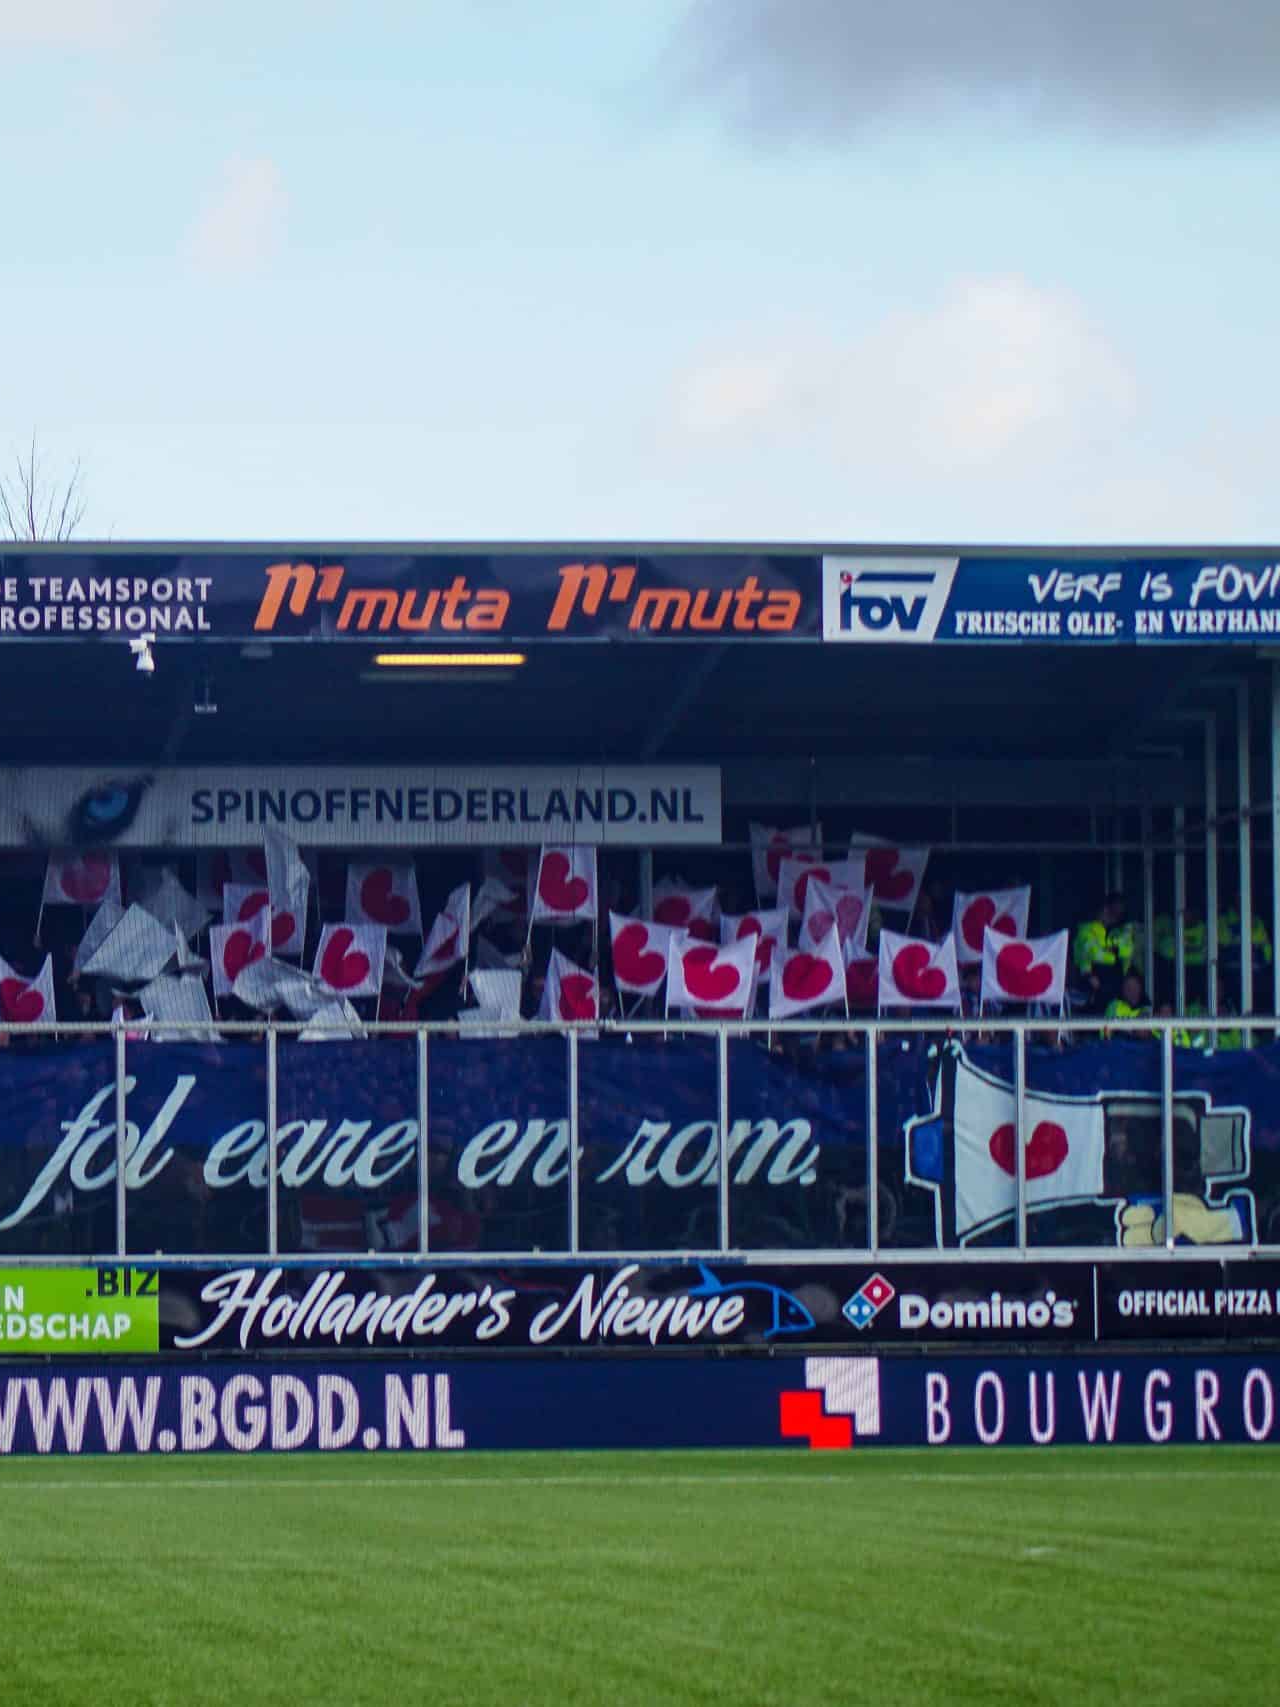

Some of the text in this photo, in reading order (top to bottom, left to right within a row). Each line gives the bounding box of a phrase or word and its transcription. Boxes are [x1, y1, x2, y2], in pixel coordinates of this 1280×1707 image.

[29, 577, 213, 602] TEAMSPORT
[335, 575, 511, 631] muta
[627, 575, 802, 631] muta
[1027, 568, 1123, 604] VERF
[1140, 570, 1173, 602] IS
[955, 611, 1061, 635] FRIESCHE
[1067, 611, 1124, 635] OLIE-
[1135, 609, 1164, 634] EN
[190, 788, 704, 824] SPINOFFNEDERLAND.NL
[203, 1118, 419, 1189] eare
[457, 1117, 584, 1188] en
[596, 1117, 821, 1186] rom.
[85, 1267, 159, 1298] .BIZ
[173, 1264, 746, 1348] Hollander's Nieuwe
[899, 1290, 1075, 1329] Domino's
[1118, 1288, 1272, 1316] OFFICIAL PIZZA
[926, 1367, 1275, 1445] BOUWGRO
